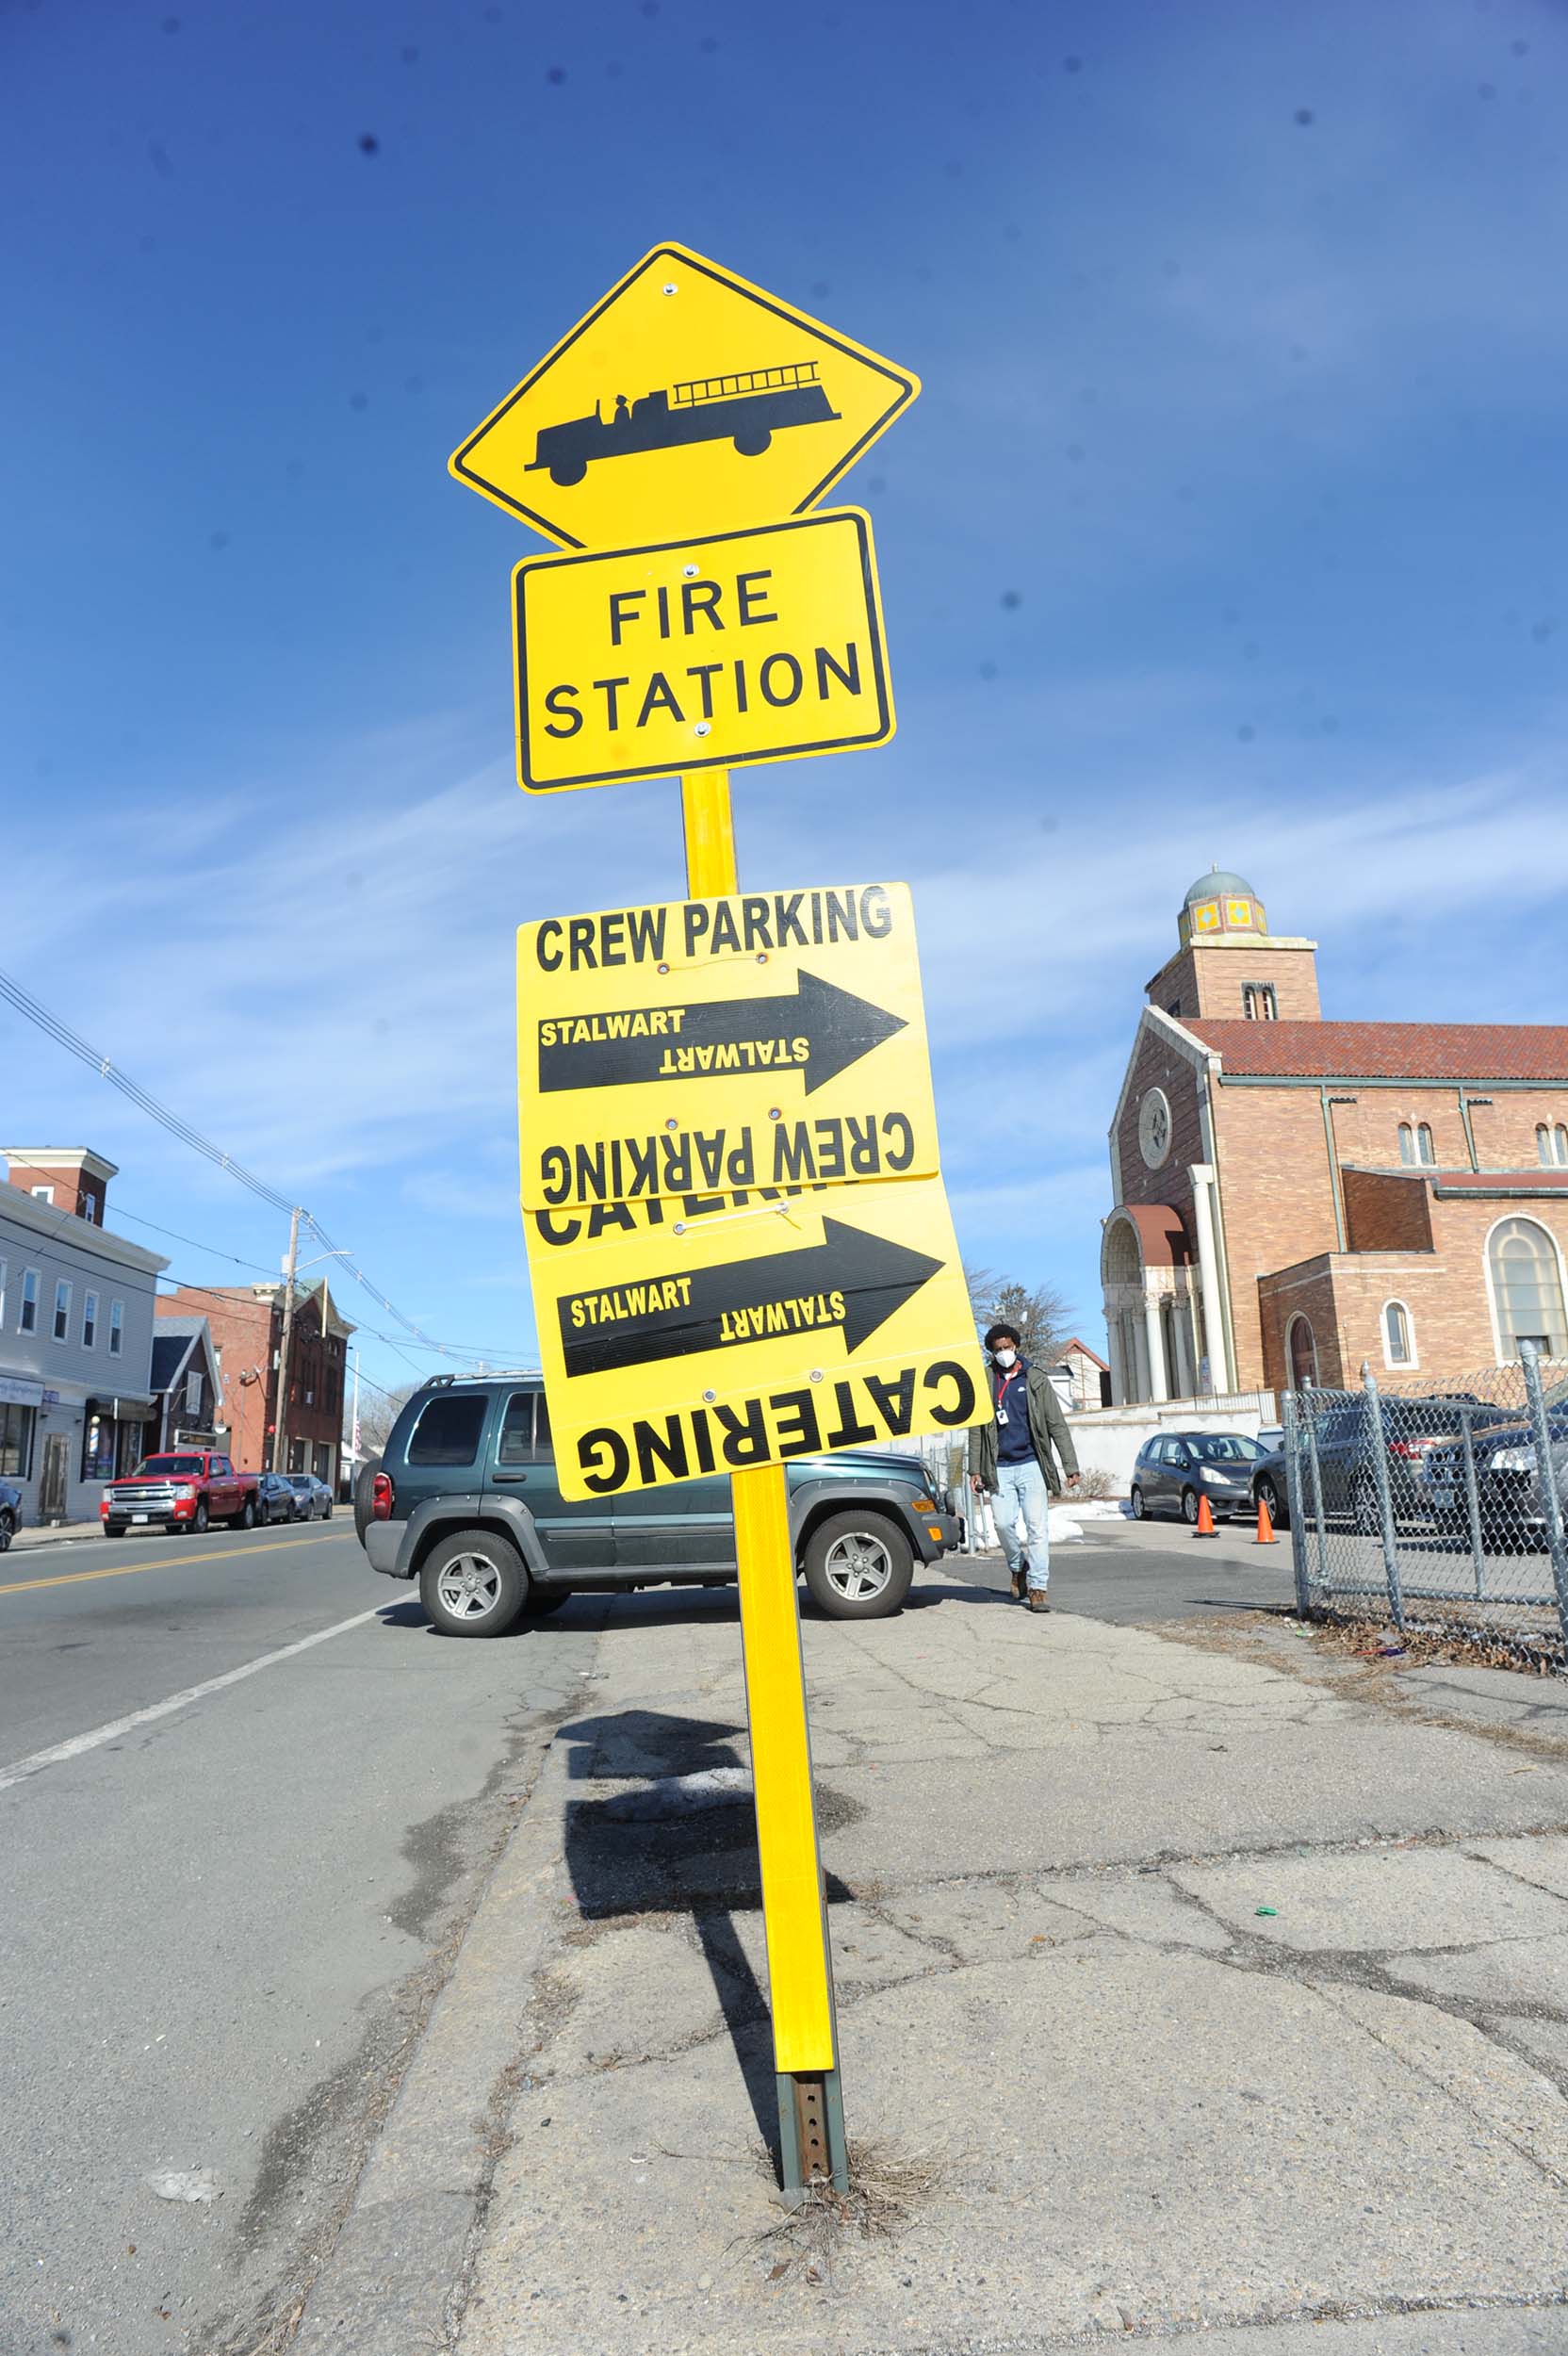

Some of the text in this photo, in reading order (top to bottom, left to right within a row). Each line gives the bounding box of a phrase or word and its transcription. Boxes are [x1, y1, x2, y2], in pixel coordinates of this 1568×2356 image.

[609, 569, 778, 646] FIRE
[544, 642, 862, 739] STATION
[536, 885, 893, 973] CREW PARKING
[540, 1009, 686, 1047] STALWART
[659, 1038, 809, 1074] STALWART
[540, 1112, 915, 1205] CREW PARKING
[570, 1278, 693, 1329] STALWART
[719, 1290, 846, 1342] STALWART
[577, 1360, 976, 1494] CATERING
